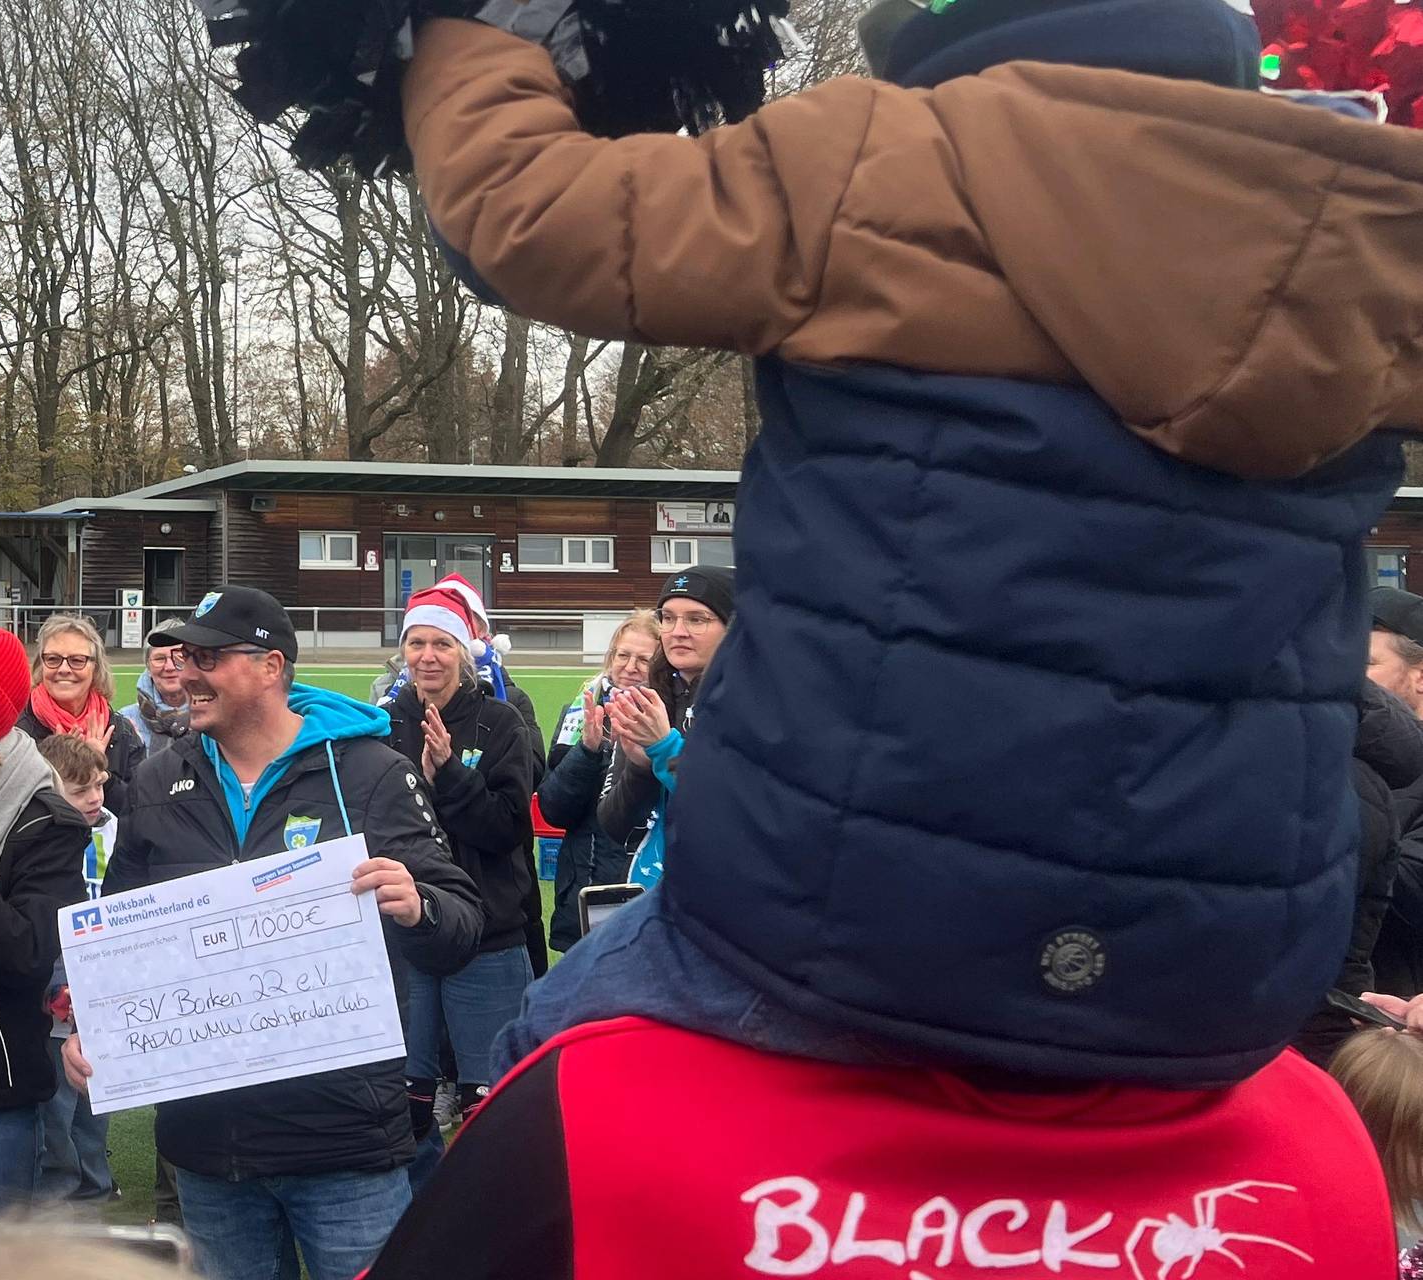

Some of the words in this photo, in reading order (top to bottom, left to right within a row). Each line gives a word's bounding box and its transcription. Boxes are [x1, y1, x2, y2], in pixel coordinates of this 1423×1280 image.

[367, 550, 377, 566] 6
[502, 553, 512, 566] 5
[255, 627, 270, 639] MT
[106, 893, 156, 914] Volksbank
[108, 897, 194, 927] Westmünsterland
[197, 894, 210, 907] eG
[249, 905, 326, 938] 1000€
[202, 931, 228, 946] EUR
[118, 993, 166, 1028] RSV
[172, 987, 242, 1016] Borken
[249, 969, 288, 1001] 22
[127, 1028, 183, 1053] RADIO
[190, 1018, 243, 1043] WMW
[740, 1175, 1121, 1276] BLACK
